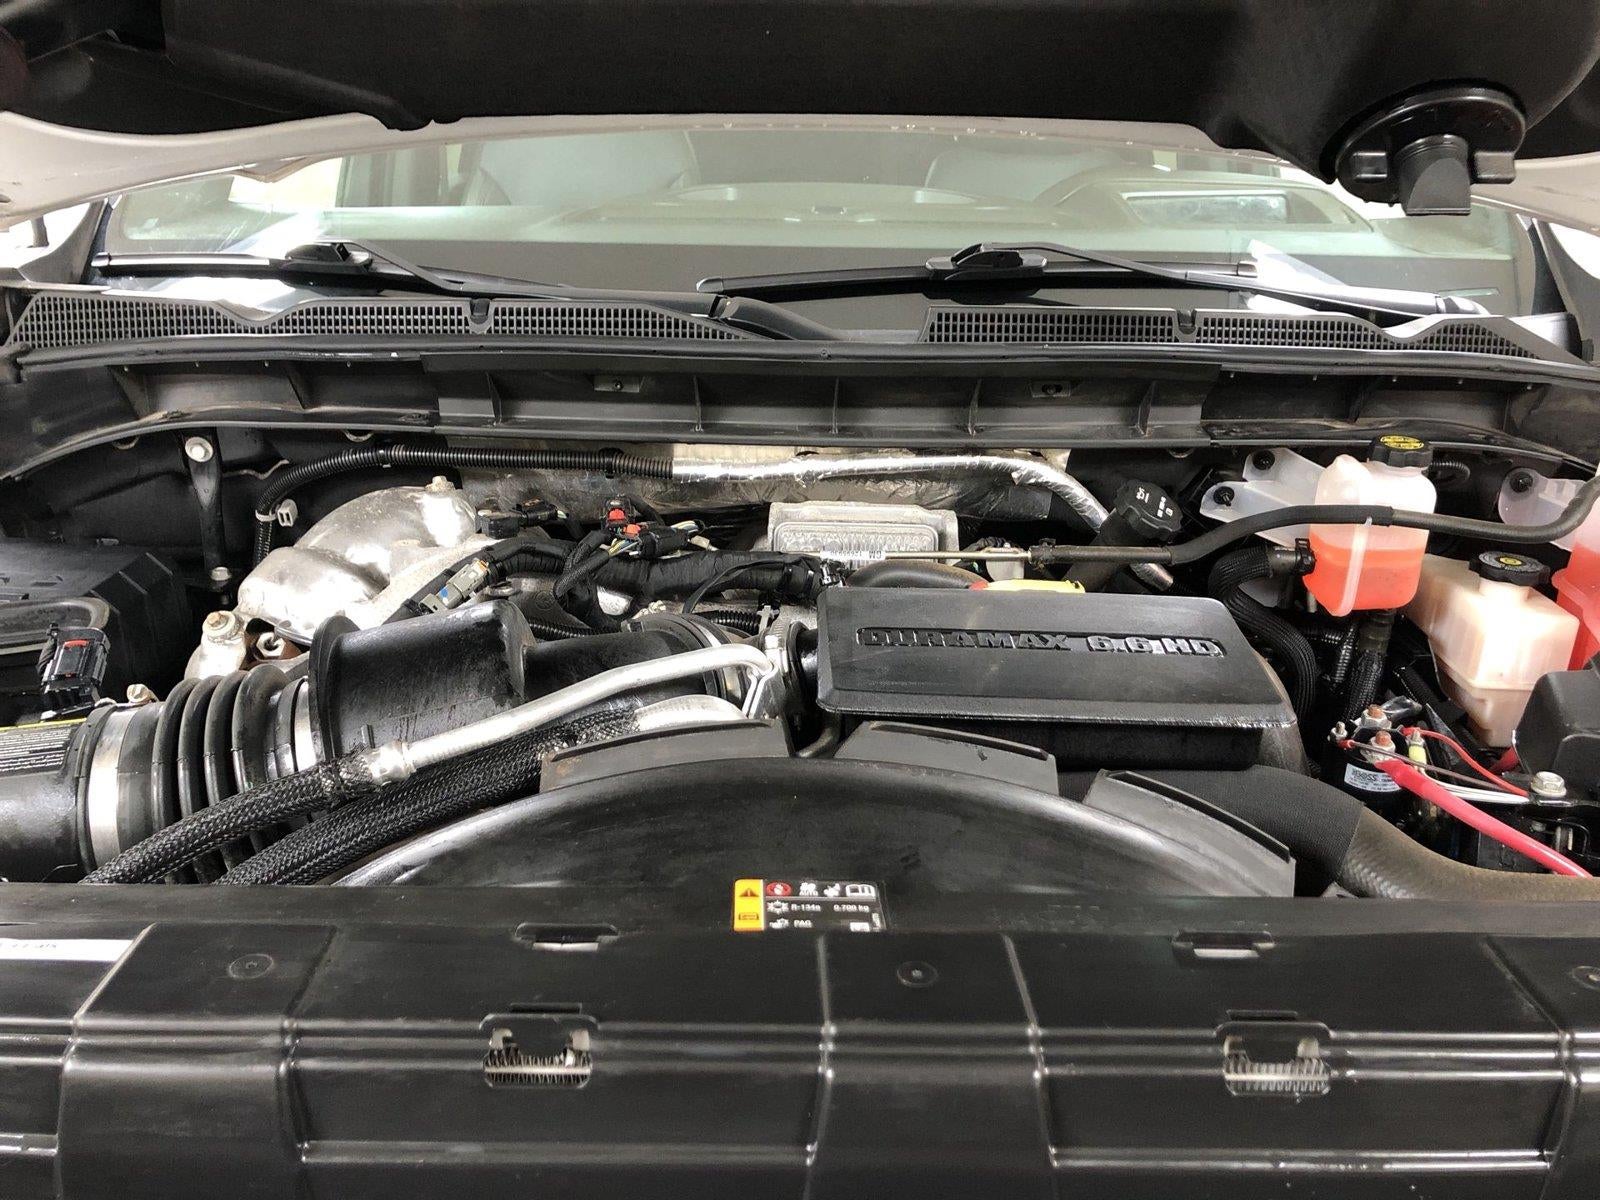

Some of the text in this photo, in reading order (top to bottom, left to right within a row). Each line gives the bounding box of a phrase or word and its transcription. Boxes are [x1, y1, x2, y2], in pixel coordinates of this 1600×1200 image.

[868, 550, 882, 559] GM
[861, 629, 1223, 657] DURAMAX 6.6 HD
[791, 903, 821, 912] R-134a
[858, 904, 870, 913] kg
